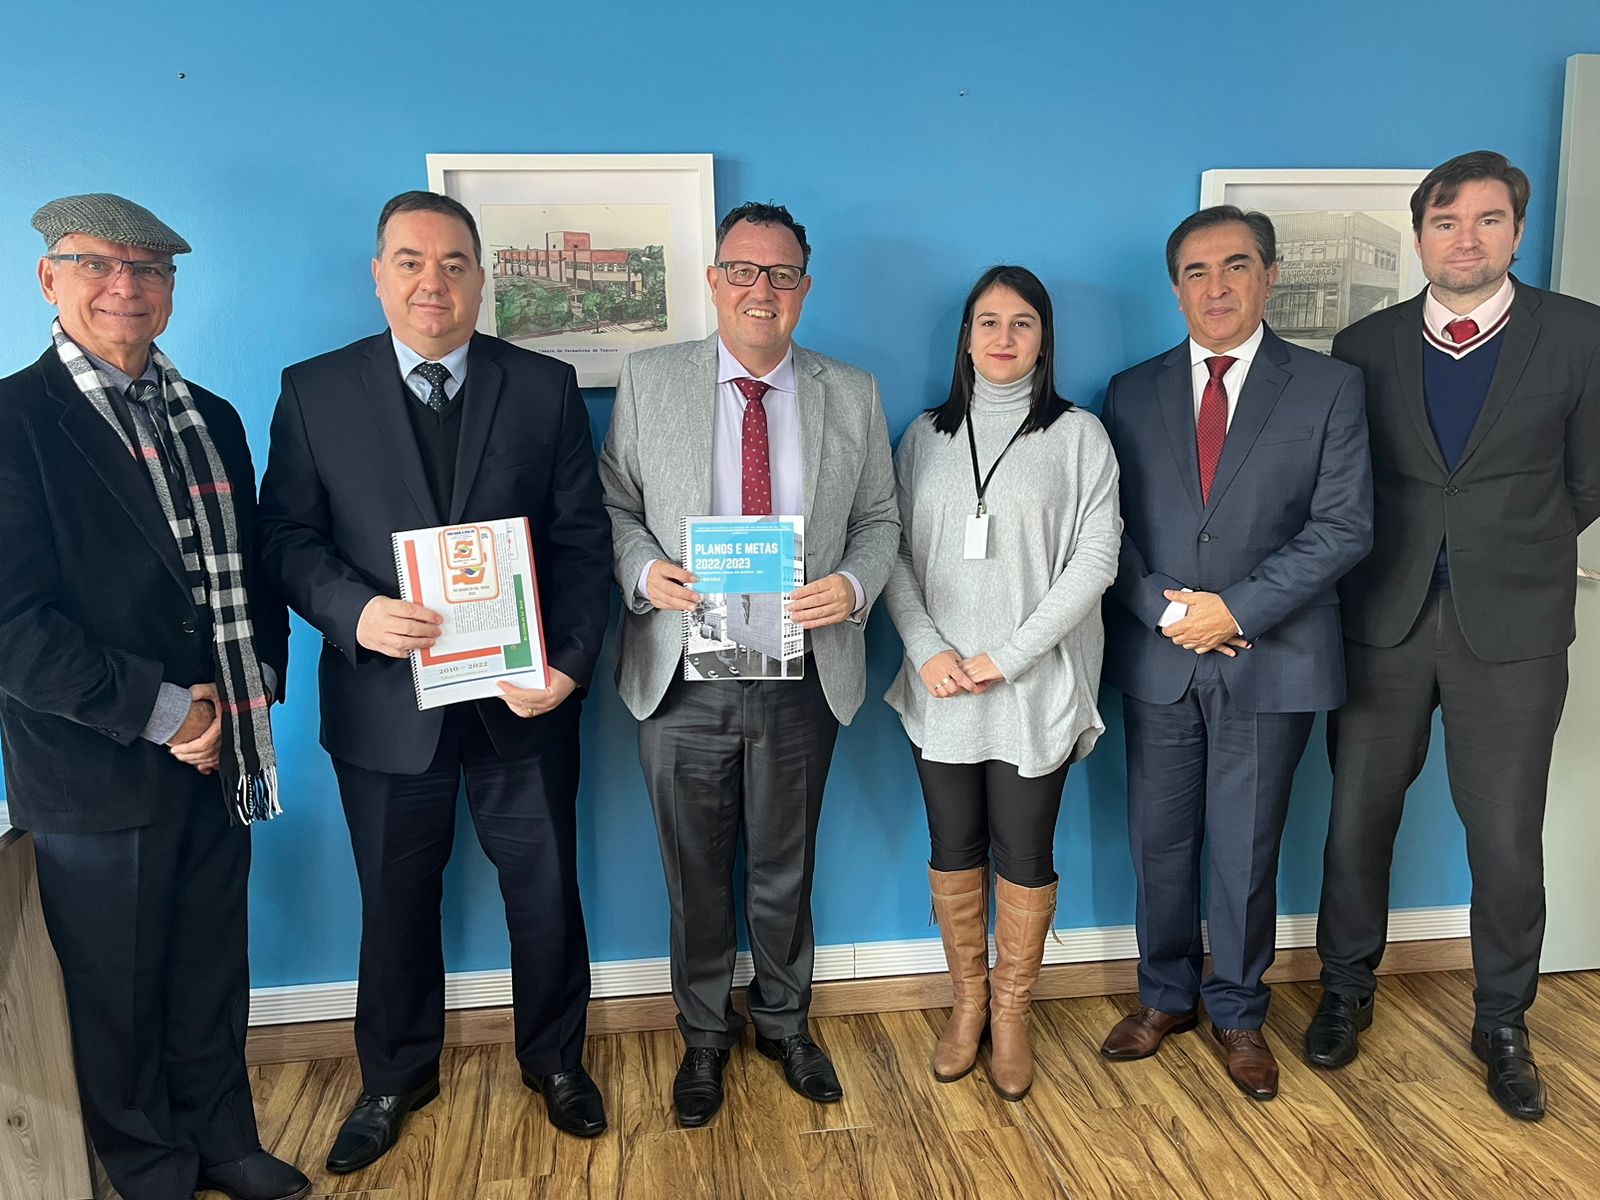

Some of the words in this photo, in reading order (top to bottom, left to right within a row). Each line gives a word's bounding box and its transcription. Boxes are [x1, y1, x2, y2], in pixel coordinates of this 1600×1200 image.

[695, 543, 733, 555] PLANOS
[736, 544, 742, 554] E
[745, 542, 778, 554] METAS
[695, 557, 751, 570] 2022/2023
[439, 666, 459, 674] 2010
[467, 661, 488, 669] 2022
